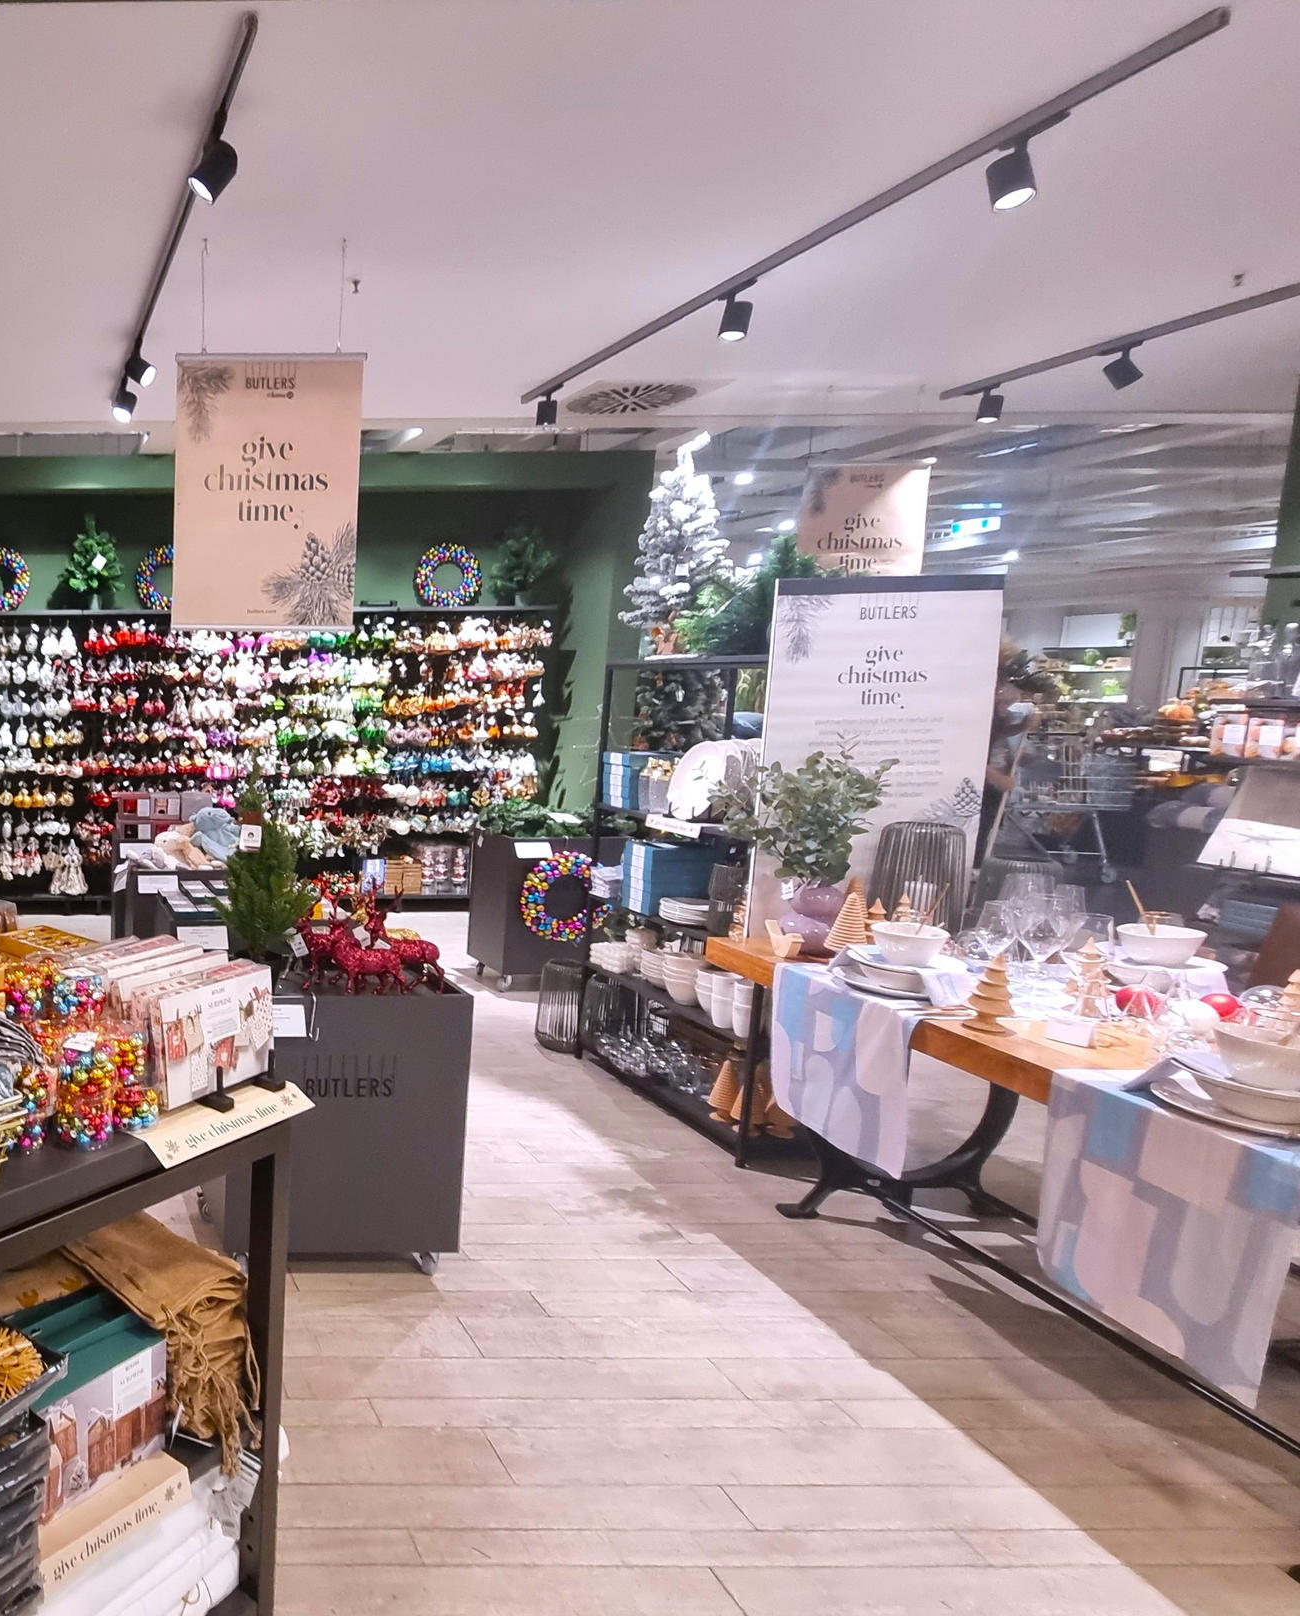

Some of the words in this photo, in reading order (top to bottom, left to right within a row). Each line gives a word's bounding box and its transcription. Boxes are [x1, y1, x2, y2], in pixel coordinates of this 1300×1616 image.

[245, 376, 295, 390] BUTLERS
[241, 436, 293, 467] give
[204, 464, 329, 491] christmas
[844, 513, 880, 533] give
[817, 531, 902, 550] christmas
[860, 605, 918, 620] BUTLERS
[865, 646, 903, 667] give
[837, 665, 928, 685] christmas
[184, 1132, 207, 1150] give
[208, 1113, 257, 1138] christmas
[53, 1556, 78, 1582] give
[80, 1520, 134, 1561] christmas
